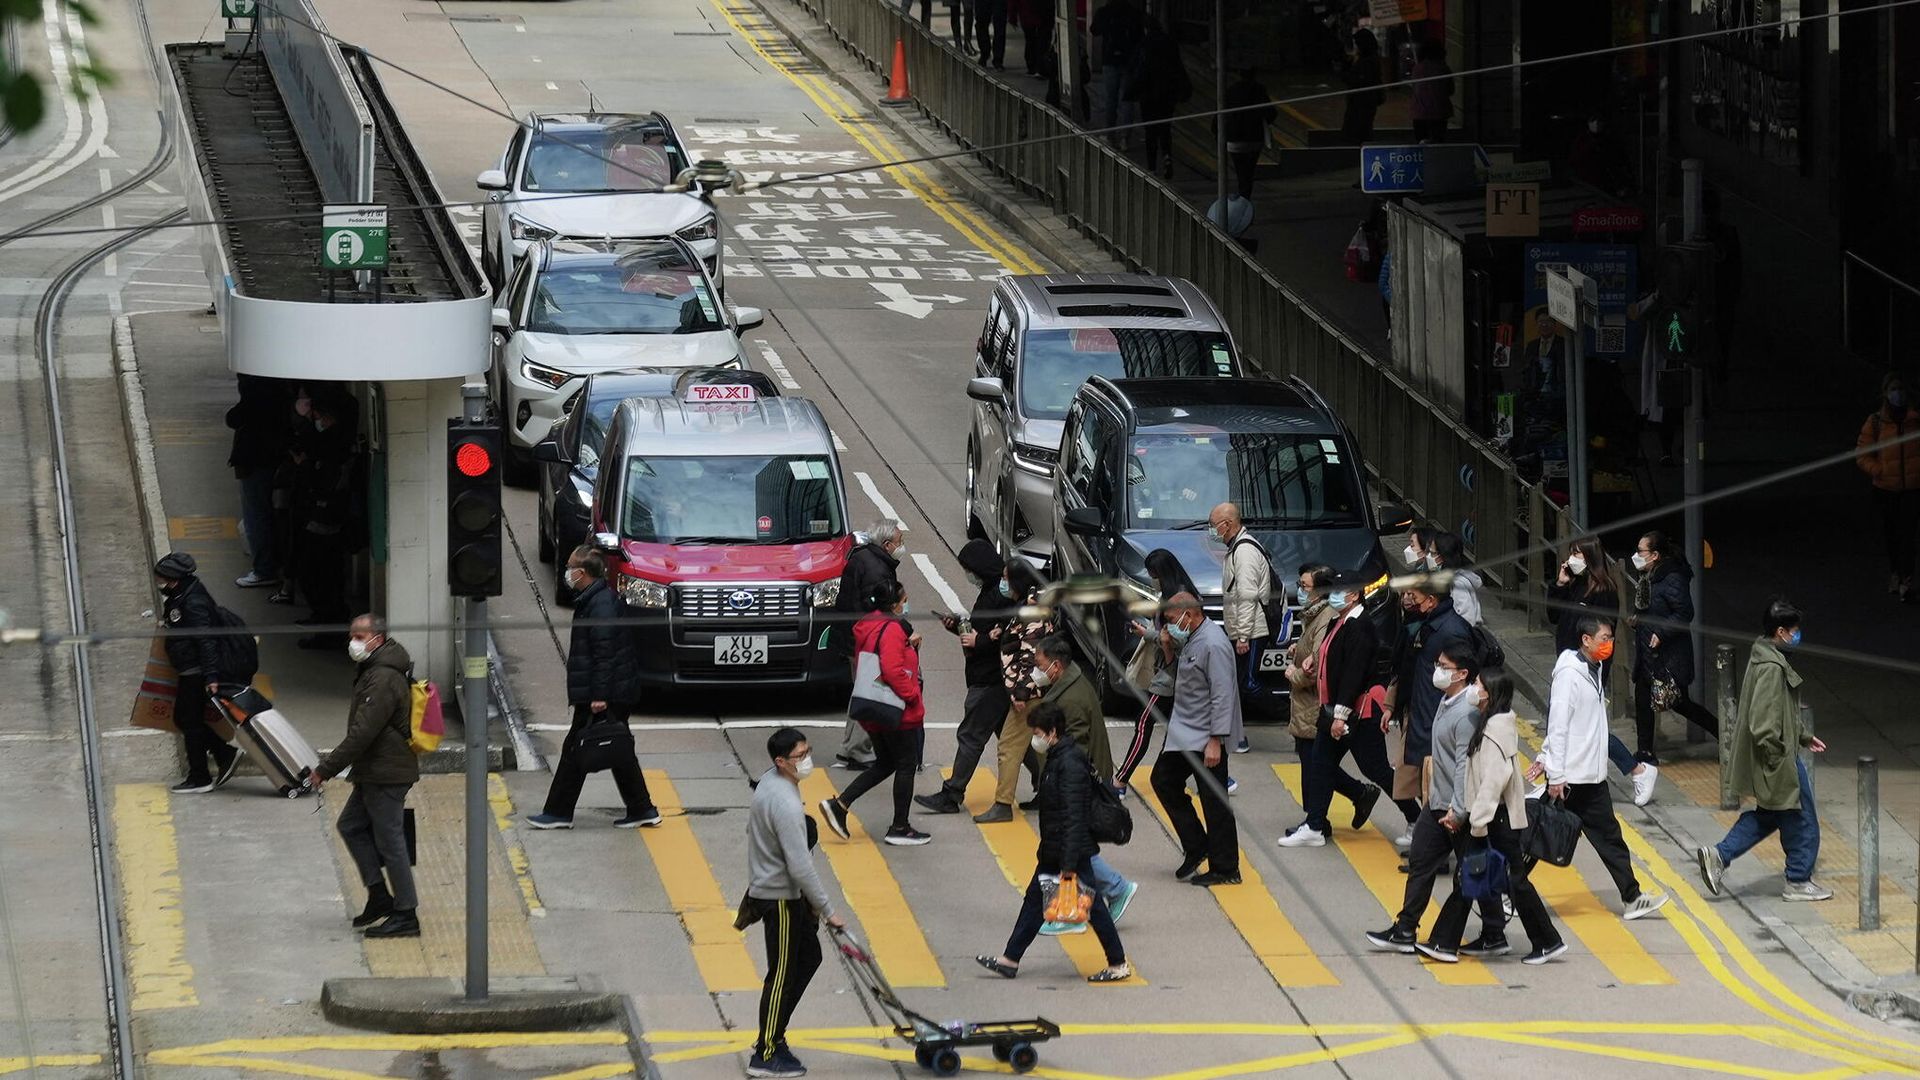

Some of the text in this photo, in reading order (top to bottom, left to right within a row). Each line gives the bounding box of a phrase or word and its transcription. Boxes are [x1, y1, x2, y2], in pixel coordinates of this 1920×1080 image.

[1491, 189, 1535, 216] FT
[1579, 213, 1641, 226] SmarTone
[693, 386, 750, 399] TAXI
[758, 519, 771, 528] TAXI
[730, 636, 753, 650] XU
[718, 650, 765, 665] 4692
